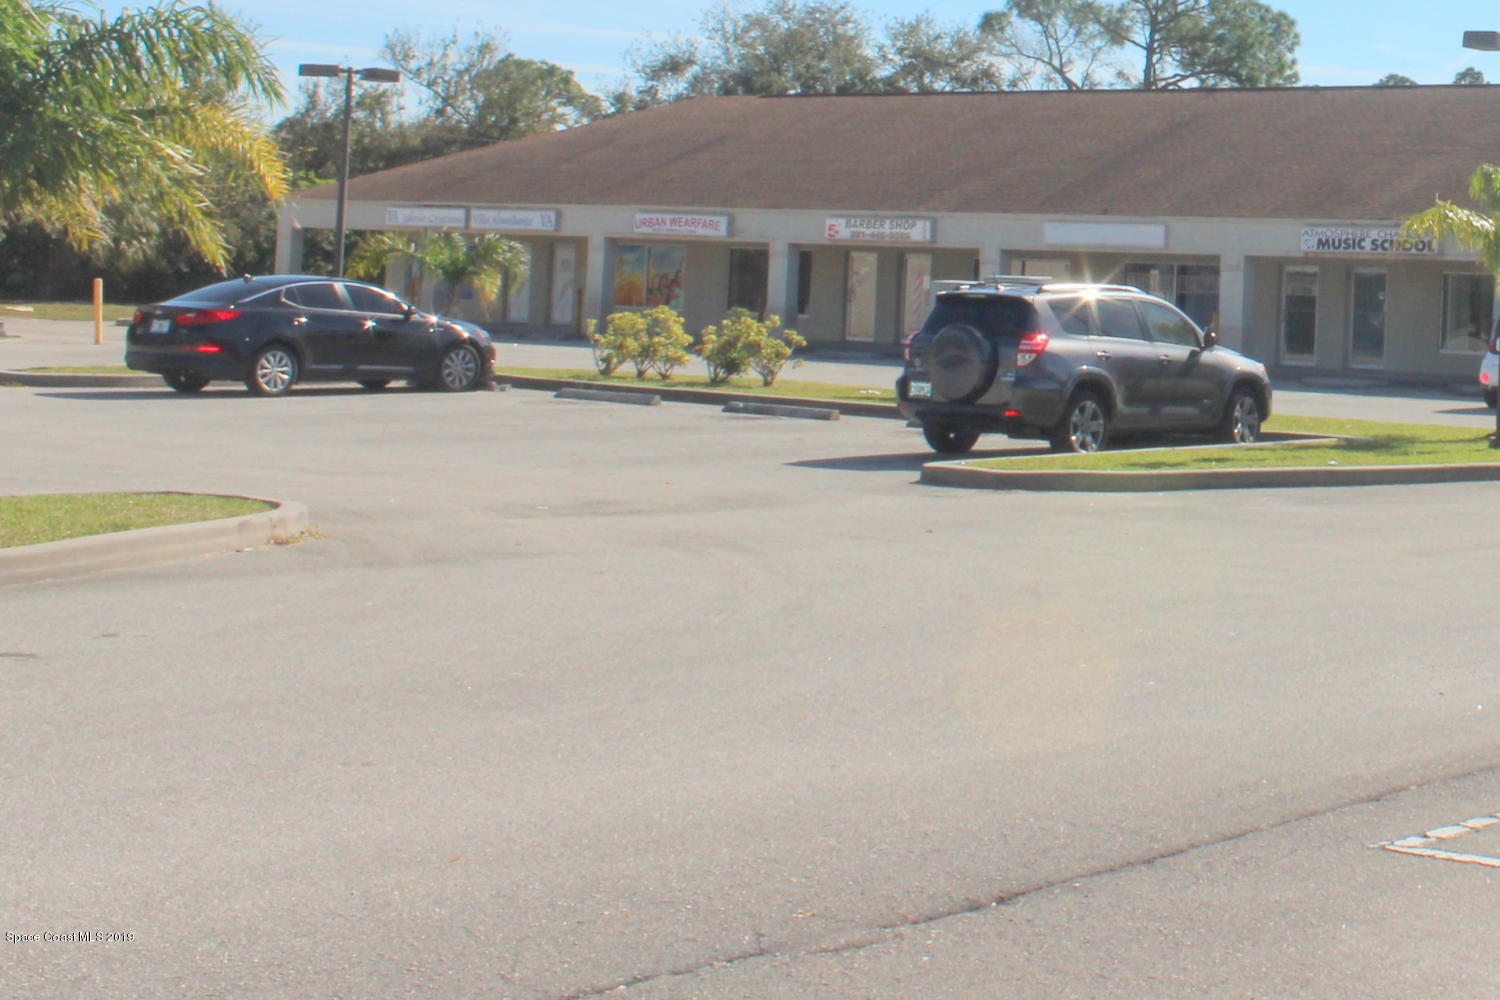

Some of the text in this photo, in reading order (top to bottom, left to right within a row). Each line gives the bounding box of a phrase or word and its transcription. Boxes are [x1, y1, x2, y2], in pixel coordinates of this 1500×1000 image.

[635, 216, 667, 230] URBAN
[845, 218, 886, 230] BARBER
[888, 219, 917, 231] SHOP
[1302, 229, 1372, 240] ATMOSPHERE
[1316, 238, 1366, 252] MUSIC
